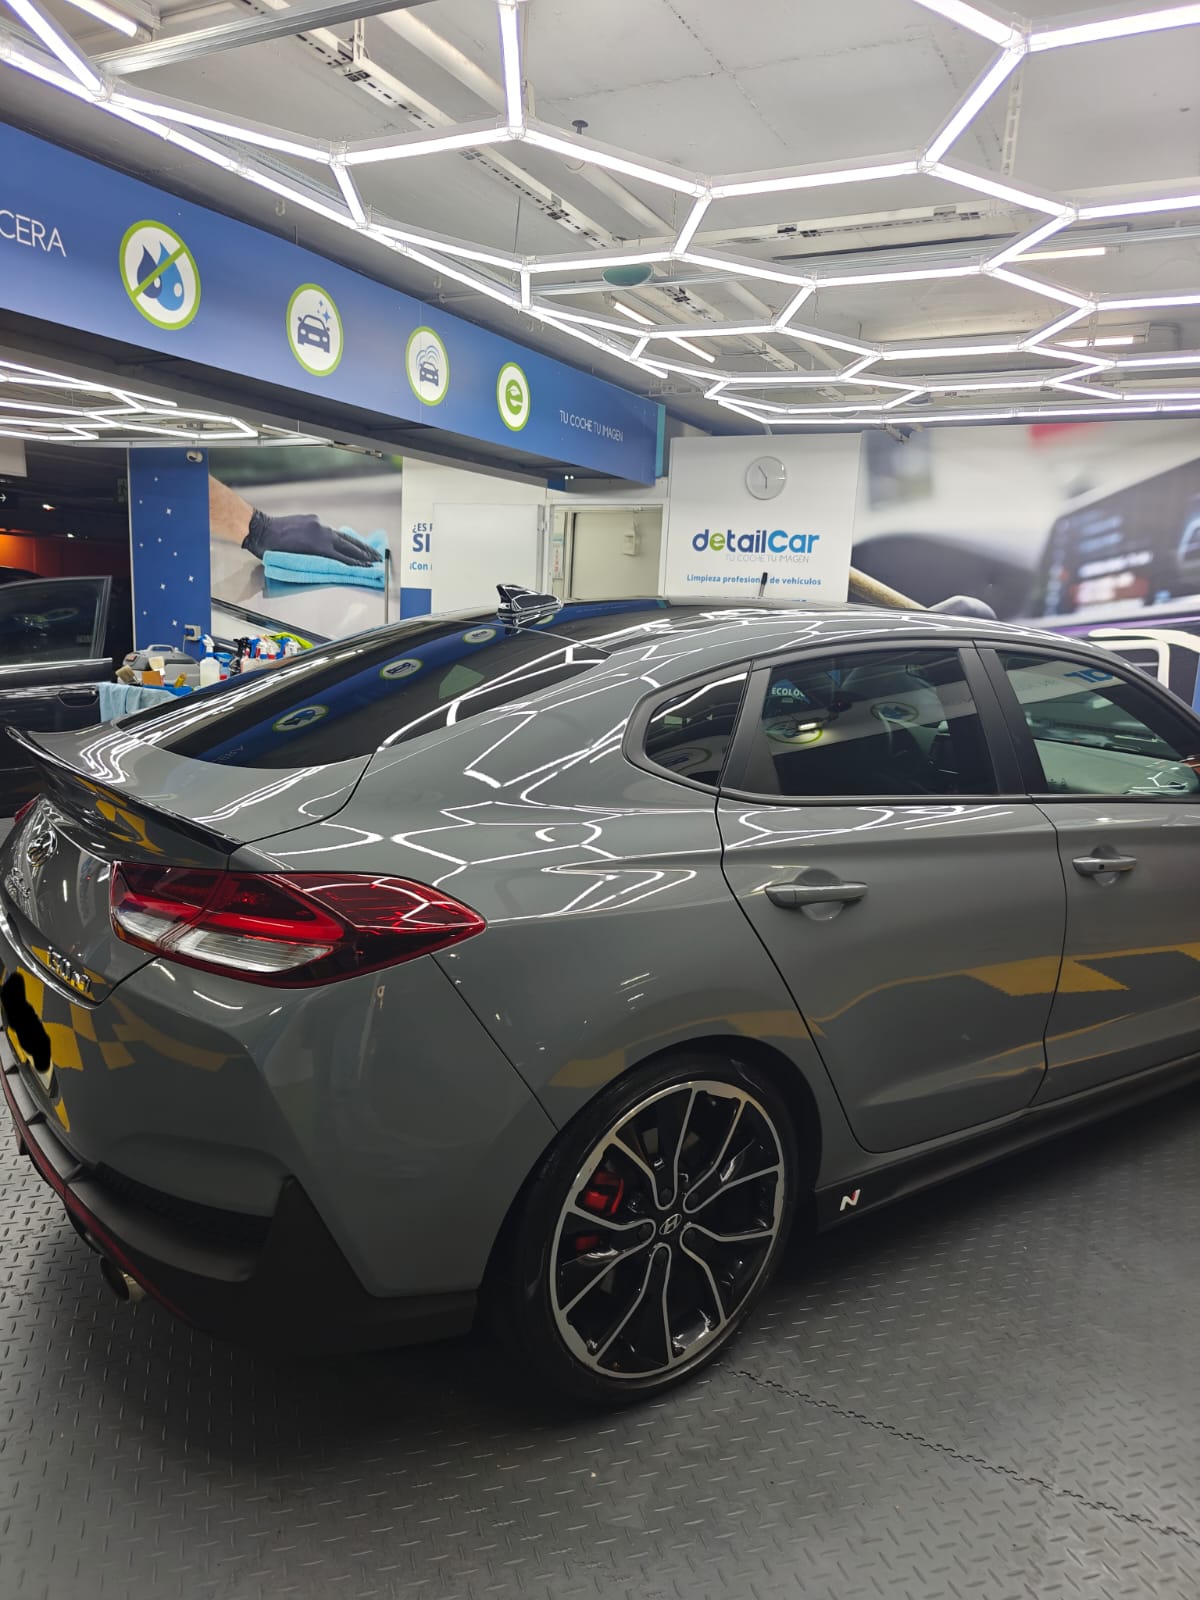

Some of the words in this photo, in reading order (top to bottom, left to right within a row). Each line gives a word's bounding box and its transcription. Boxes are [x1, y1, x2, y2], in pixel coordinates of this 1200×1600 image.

[0, 209, 67, 258] CERA
[559, 410, 569, 424] TU
[569, 414, 592, 432] COCHE
[593, 421, 602, 435] TU
[602, 425, 624, 442] IMAGEN
[692, 529, 820, 553] detailCar
[687, 573, 720, 584] Limpieza
[722, 575, 768, 585] profesion
[769, 576, 780, 584] de
